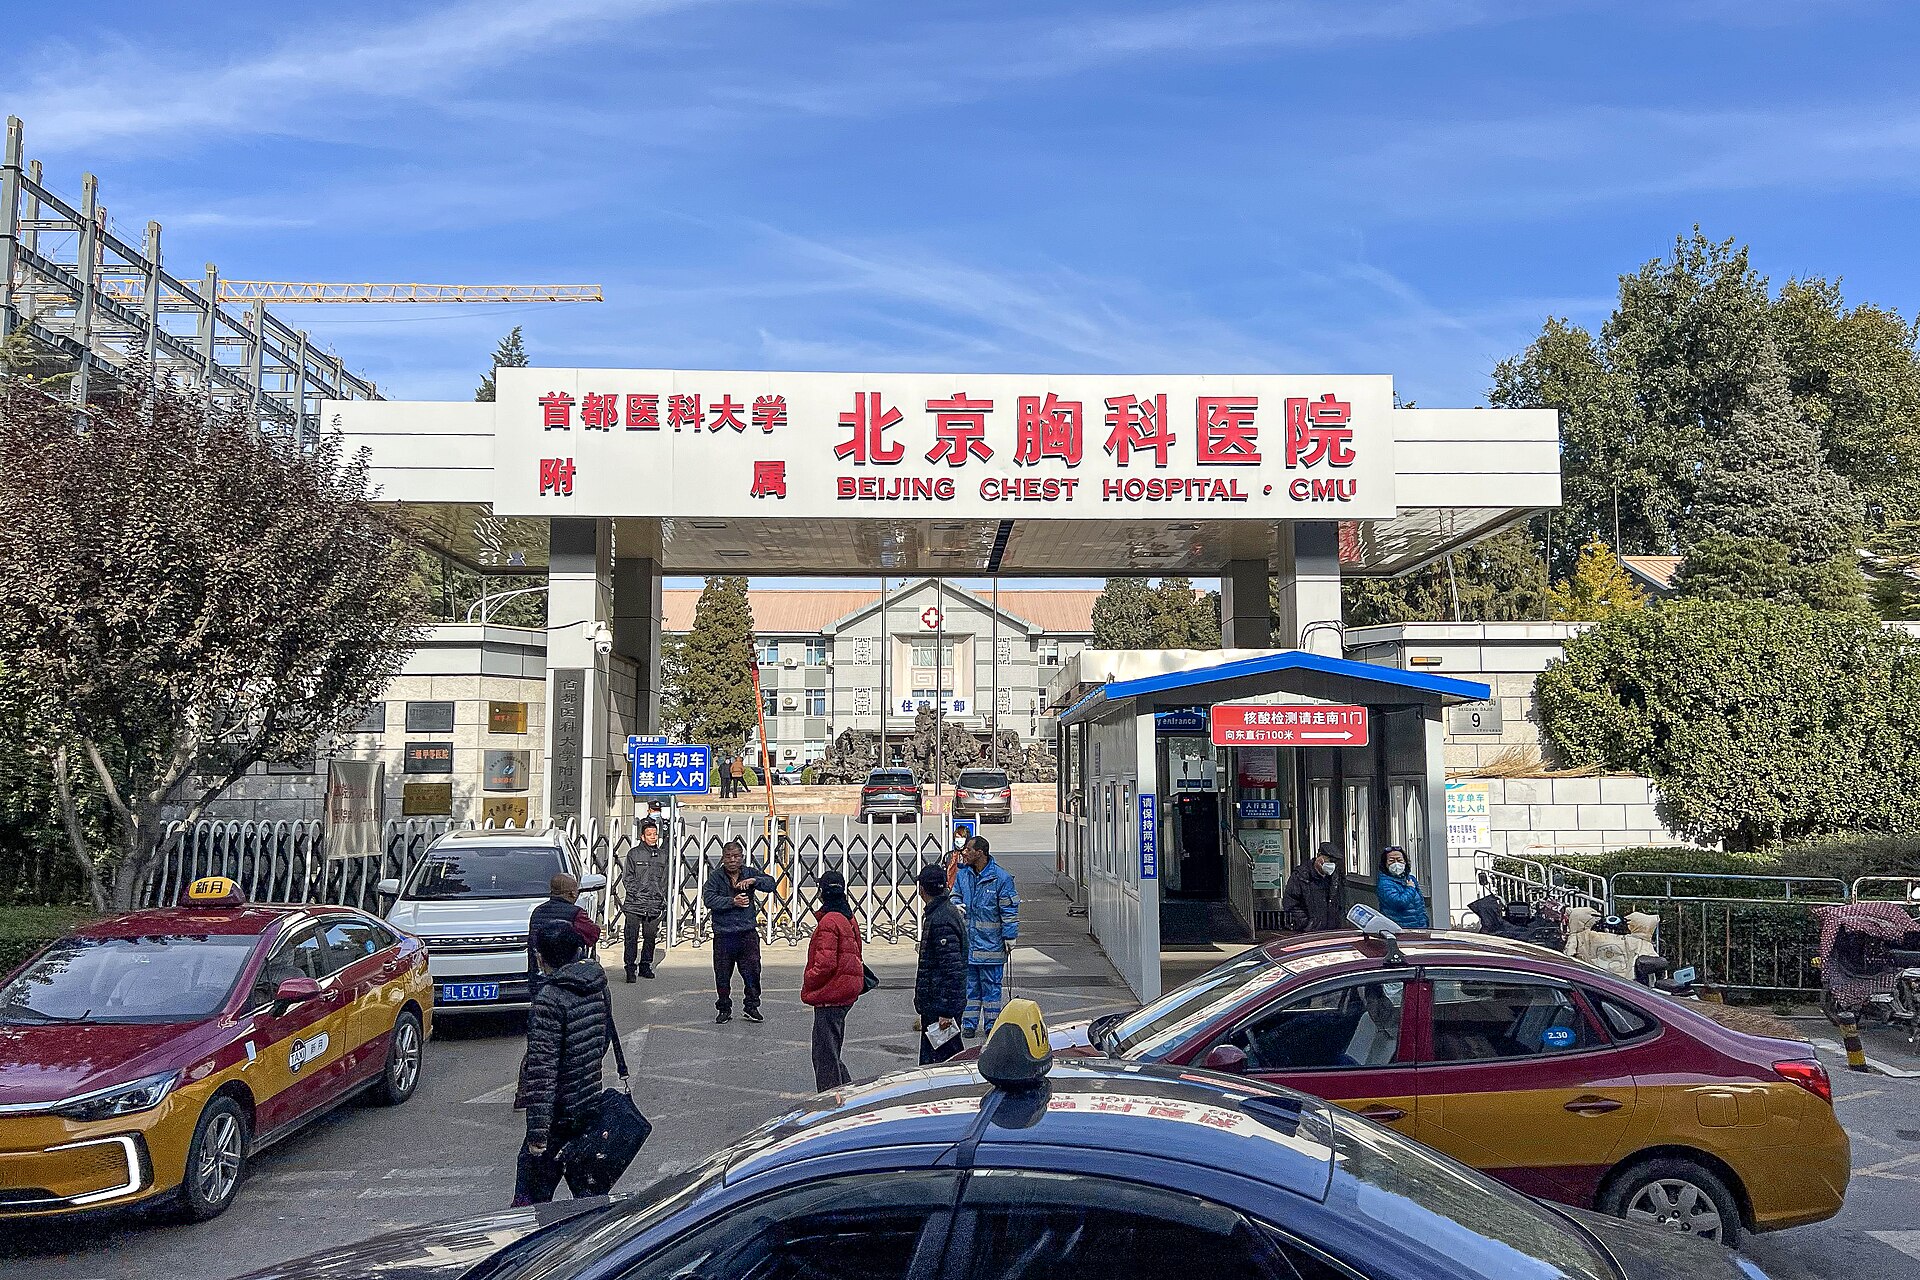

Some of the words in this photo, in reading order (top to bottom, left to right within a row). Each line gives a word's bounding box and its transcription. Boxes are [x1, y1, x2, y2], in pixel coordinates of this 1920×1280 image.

[538, 391, 788, 434] 首都医科大学
[834, 391, 1357, 470] 北京胸科医院
[836, 476, 956, 501] BEIJING
[979, 477, 1080, 502] CHEST
[1102, 477, 1249, 502] HOSPITAL
[1288, 478, 1357, 503] CMU
[1243, 711, 1364, 726] 核酸检测请走南1门
[1471, 712, 1481, 728] 9
[1225, 730, 1294, 741] 向东直行100米
[639, 752, 705, 769] 非机动车
[638, 770, 704, 788] 禁止入内
[1447, 793, 1486, 803] 共享单车
[1447, 804, 1486, 814] 禁止入内
[1142, 797, 1154, 876] 请保持两米距离
[195, 880, 223, 894] 新月
